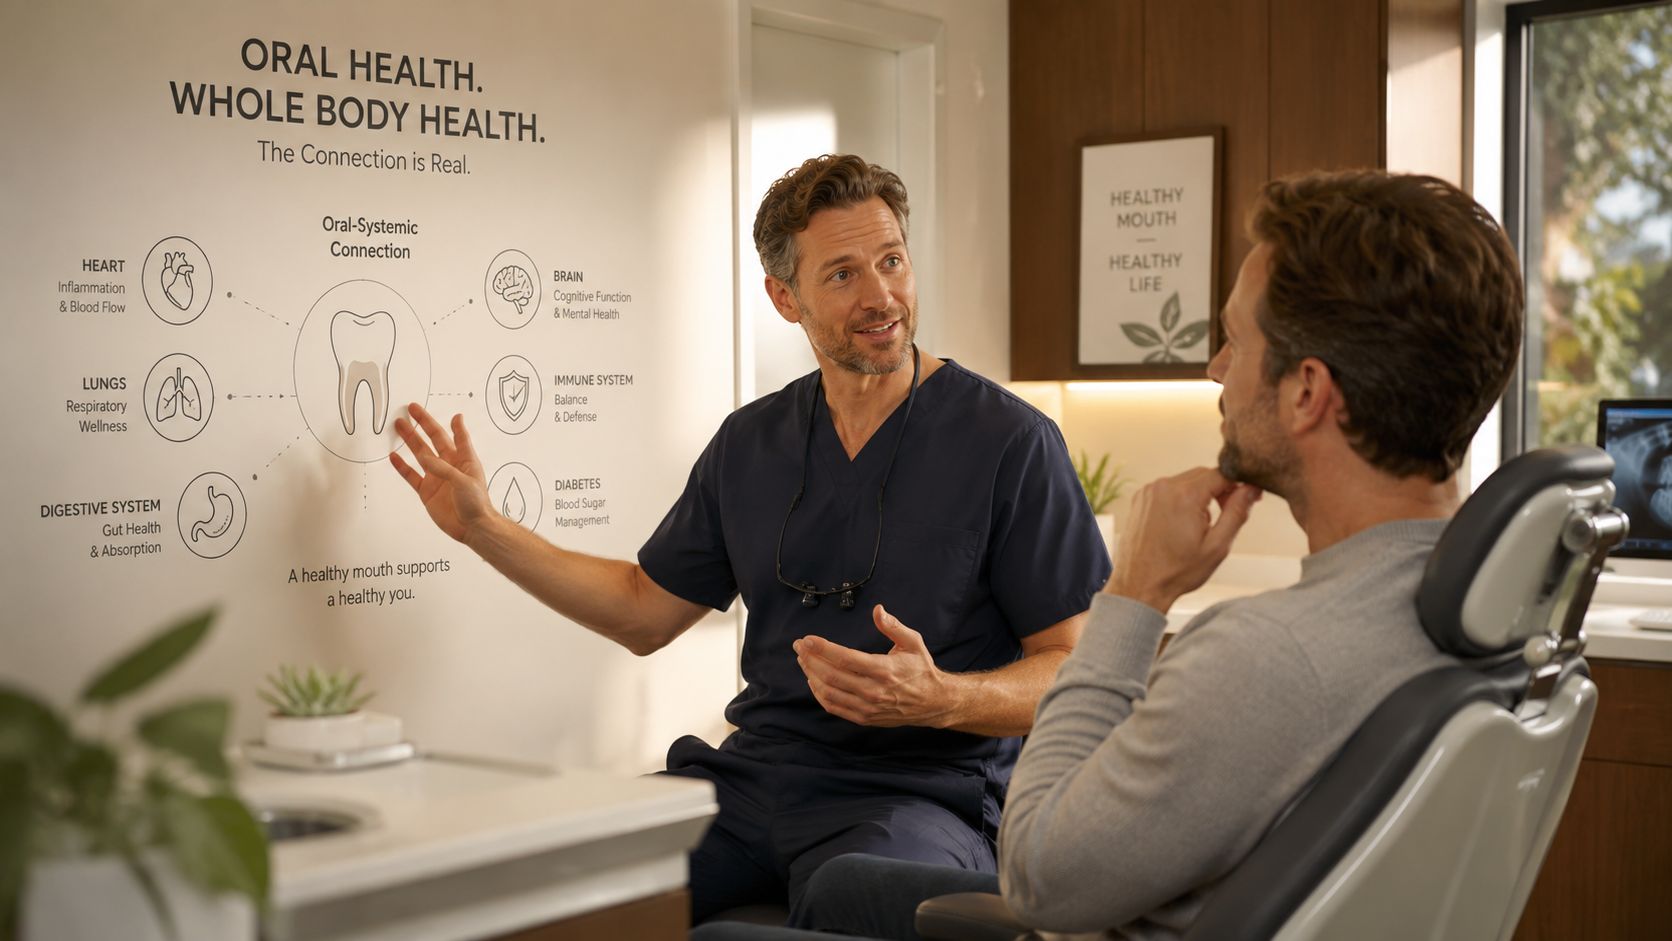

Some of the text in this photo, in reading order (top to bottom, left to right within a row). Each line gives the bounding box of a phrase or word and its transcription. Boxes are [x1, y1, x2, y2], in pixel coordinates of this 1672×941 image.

[241, 38, 482, 93] ORAL HEALTH.
[170, 81, 545, 143] WHOLE BODY HEALTH.
[257, 140, 470, 174] The Connection is Real.
[1110, 187, 1183, 207] HEALTHY
[323, 216, 418, 236] Oral-Systemic
[1117, 211, 1176, 228] MOUTH
[331, 241, 410, 259] Connection
[83, 259, 125, 272] HEART
[1109, 253, 1182, 270] HEALTHY
[554, 270, 583, 282] BRAIN
[59, 281, 125, 294] Inflammation
[1129, 276, 1162, 292] LIFE
[553, 288, 631, 304] Cognitive Function
[59, 300, 126, 313] & Blood Flow
[554, 307, 619, 319] & Mental Health
[83, 377, 126, 390] LUNGS
[555, 375, 633, 386] IMMUNE SYSTEM
[555, 394, 587, 405] Balance
[67, 400, 127, 415] Respiratory
[554, 410, 597, 423] & Defense
[79, 419, 127, 432] Wellness
[555, 478, 600, 491] DIABETES
[41, 499, 160, 518] DIGESTIVE SYSTEM
[555, 497, 606, 510] Blood Sugar
[103, 521, 161, 536] Gut Health
[555, 515, 610, 529] Management
[90, 541, 161, 558] & Absorption
[288, 559, 450, 583] A healthy mouth supports
[328, 587, 415, 607] a healthy you.
